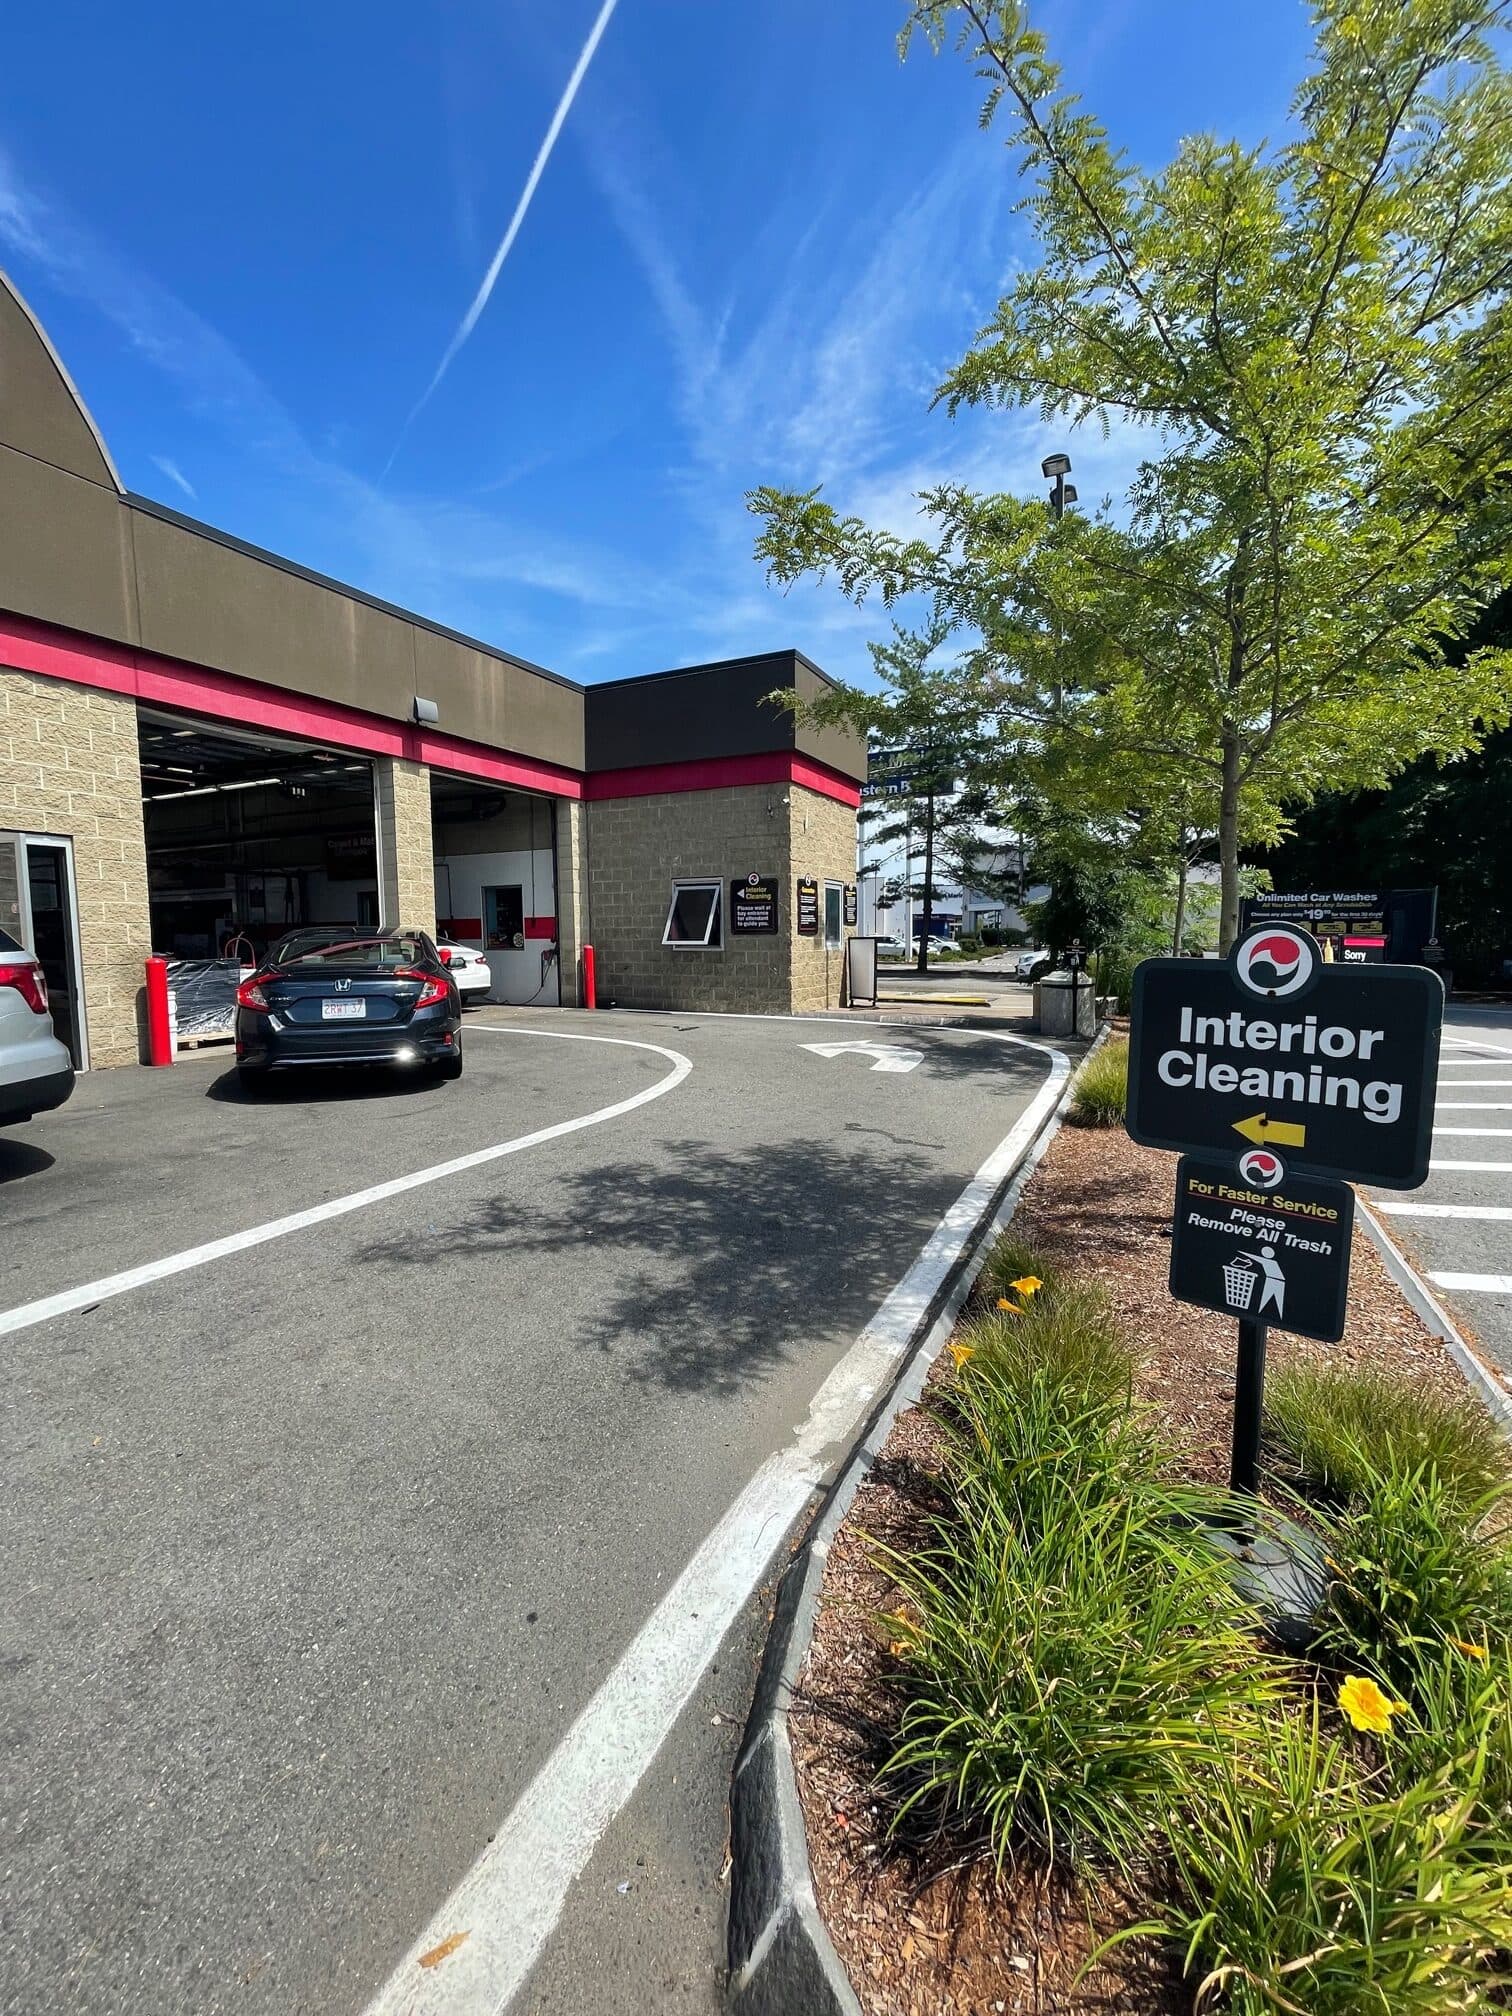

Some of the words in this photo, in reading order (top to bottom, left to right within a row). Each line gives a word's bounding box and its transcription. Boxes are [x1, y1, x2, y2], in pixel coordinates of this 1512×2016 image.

[1256, 893, 1308, 902] Unlimited
[1309, 893, 1330, 901] Car
[1332, 893, 1378, 901] Washes
[1344, 949, 1366, 962] Sorry
[1180, 1006, 1384, 1060] Interior
[1158, 1050, 1402, 1124] Cleaning
[1188, 1178, 1215, 1195] For
[1218, 1184, 1269, 1206] Faster
[1272, 1195, 1338, 1220] Service
[1230, 1208, 1286, 1230] Please
[1187, 1212, 1253, 1238] Remove
[1256, 1228, 1281, 1244] All
[1284, 1233, 1333, 1256] Trash
